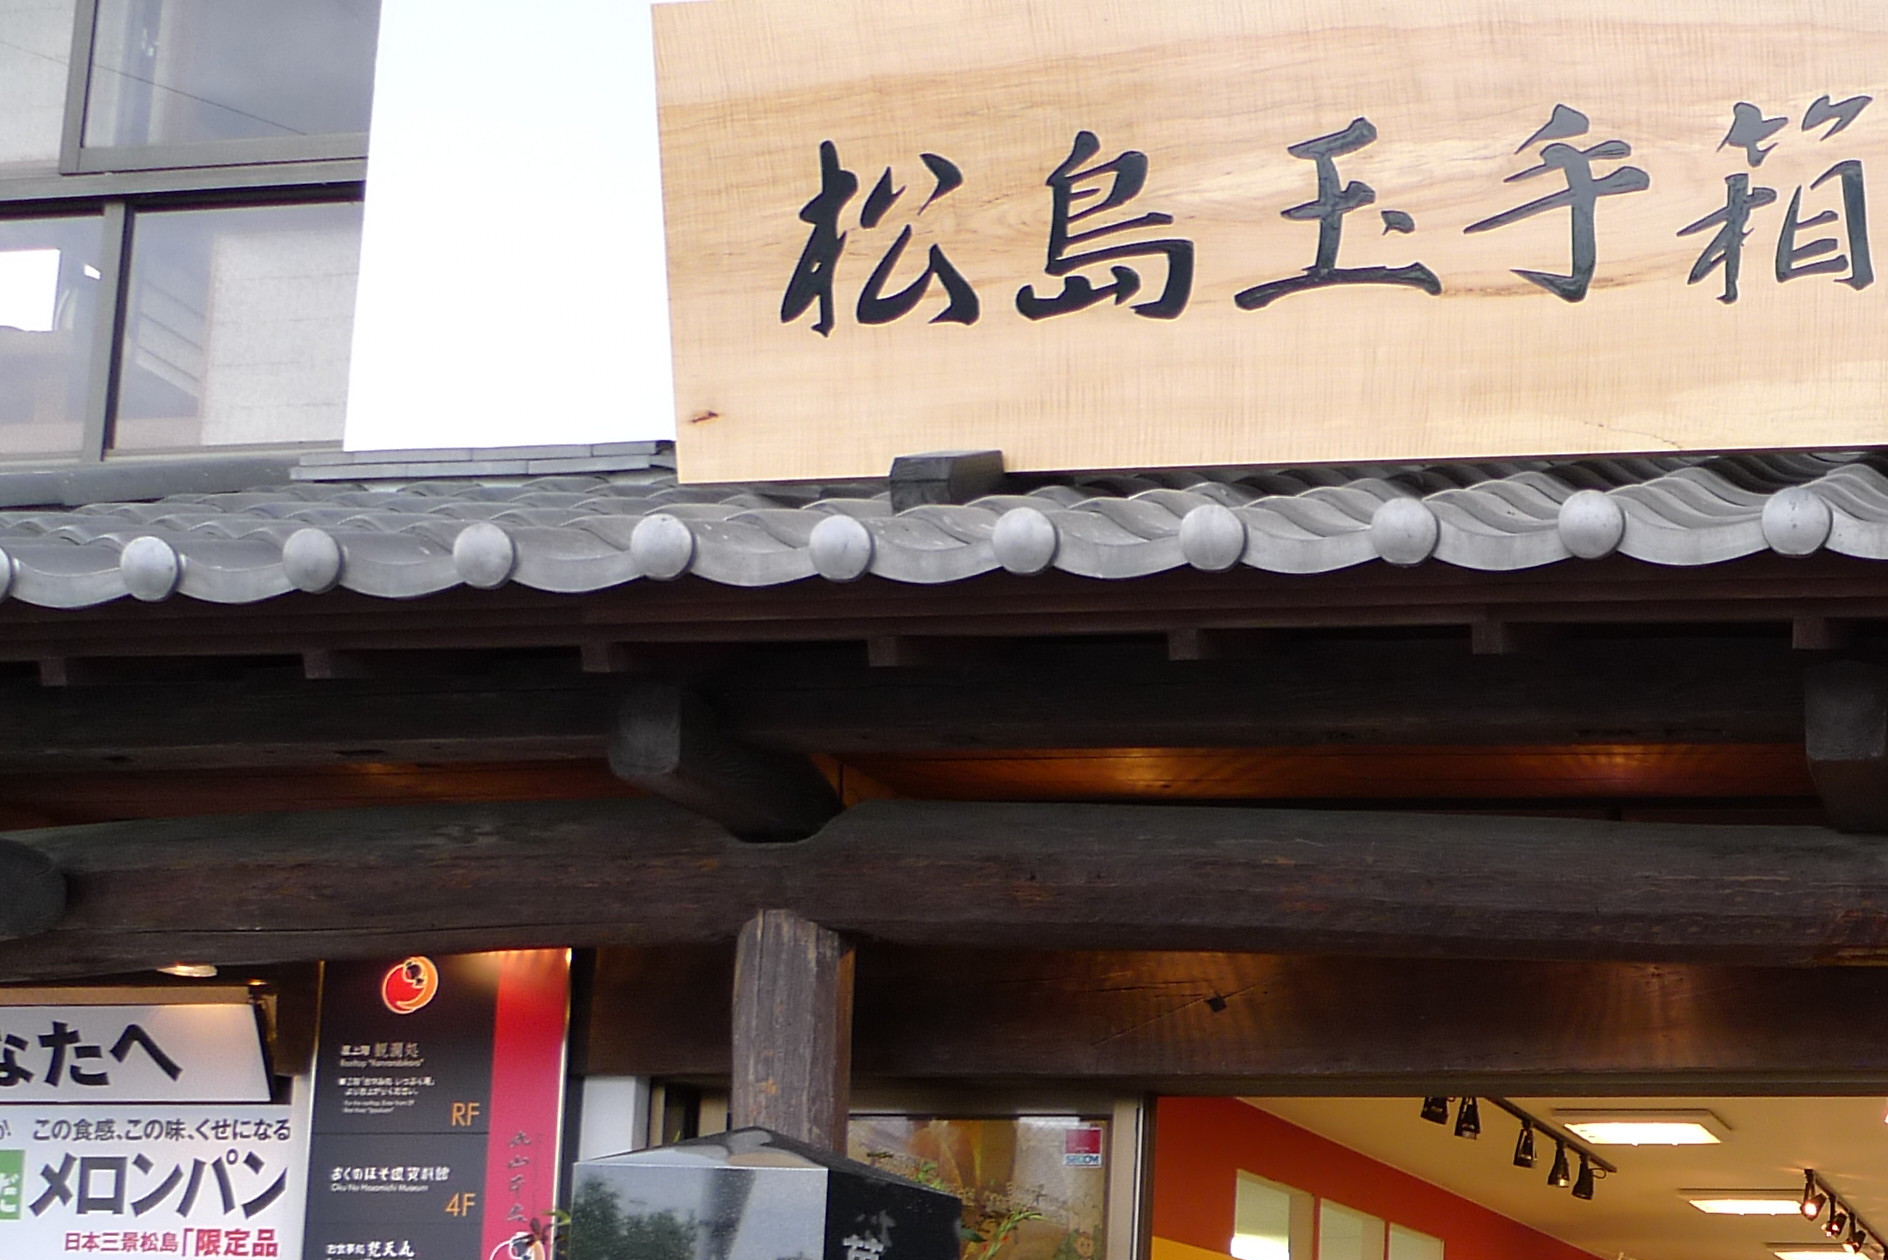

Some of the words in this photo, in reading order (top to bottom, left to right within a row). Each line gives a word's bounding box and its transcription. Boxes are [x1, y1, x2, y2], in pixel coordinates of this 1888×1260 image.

[452, 1102, 480, 1127] RF
[32, 1117, 292, 1142] この食感、この味、くせになる
[28, 1150, 288, 1220] メロンパン
[445, 1193, 476, 1216] 4F
